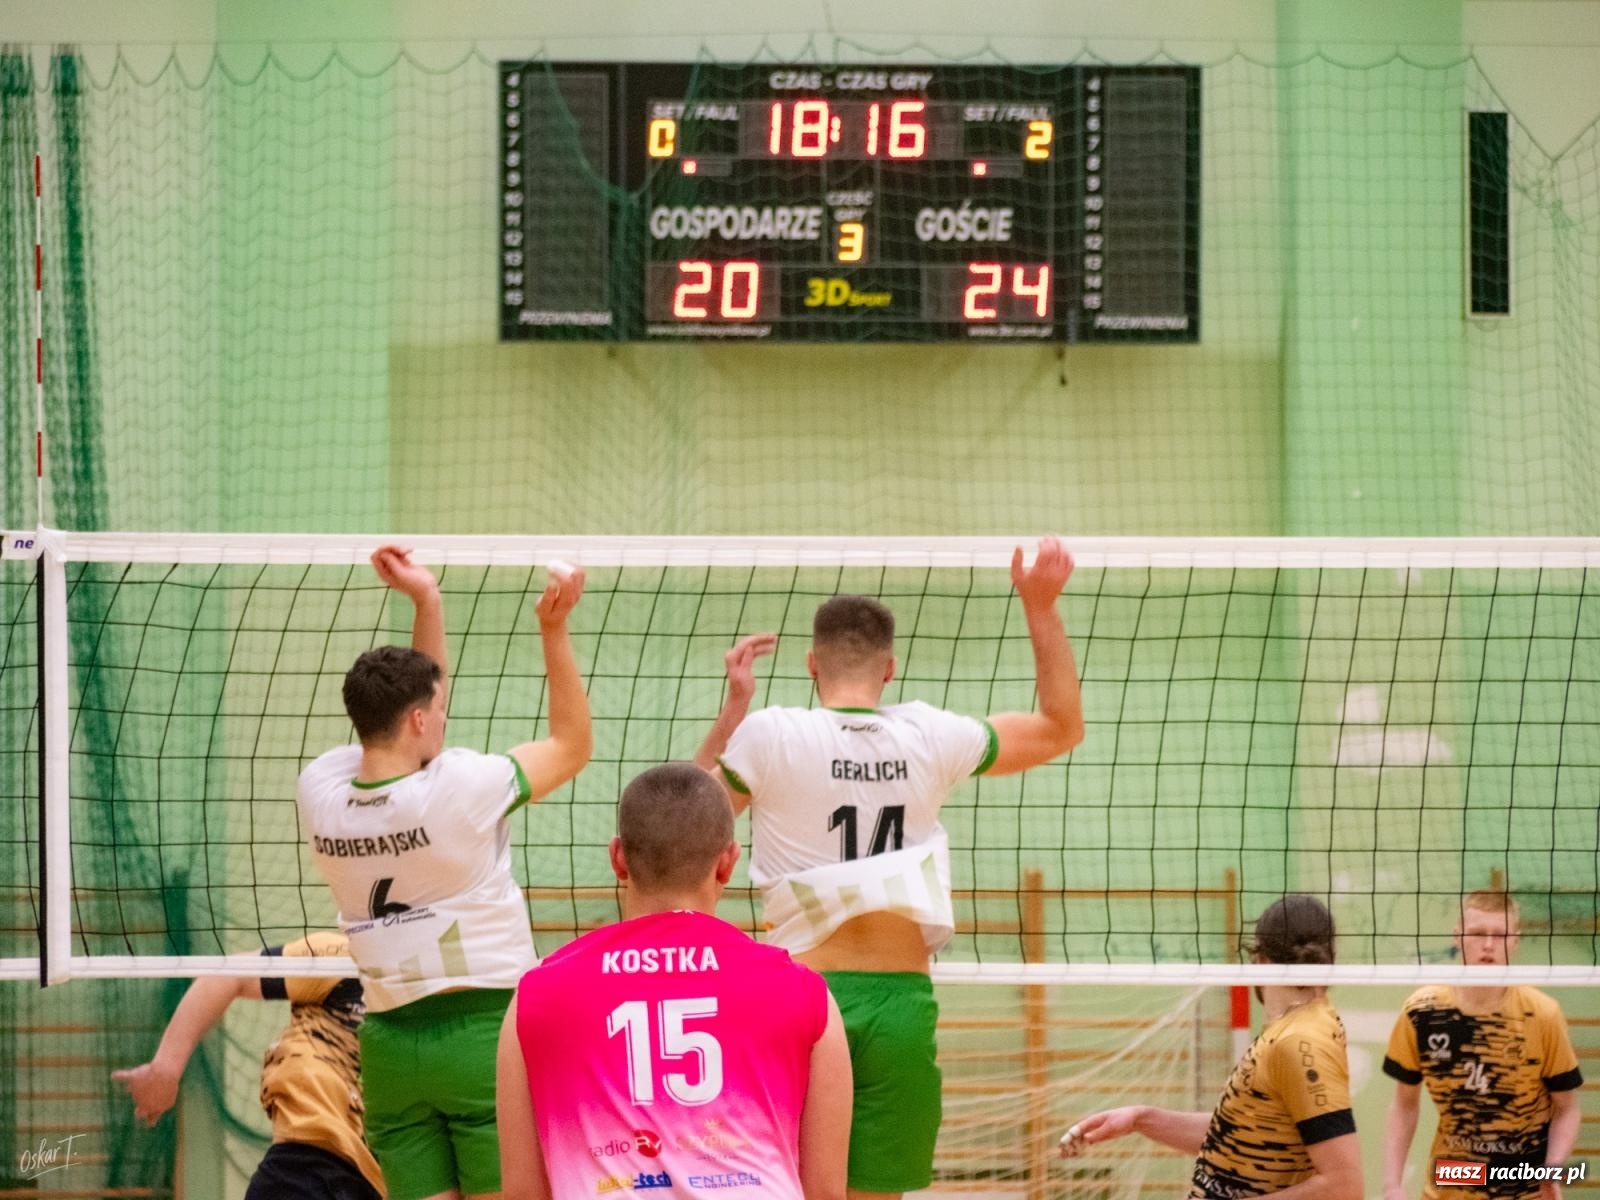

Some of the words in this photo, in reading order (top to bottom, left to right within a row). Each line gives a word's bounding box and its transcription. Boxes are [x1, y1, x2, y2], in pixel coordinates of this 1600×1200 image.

[769, 72, 822, 90] CZAS
[836, 72, 888, 90] CZAS
[891, 72, 933, 91] GRY
[1024, 121, 1053, 160] 2
[650, 205, 824, 240] GOSPODARZE
[915, 200, 1014, 242] GOŚCIE
[837, 222, 865, 262] 3
[674, 261, 761, 319] 20
[963, 263, 1050, 320] 24
[831, 758, 909, 783] GERLICH
[313, 826, 431, 857] SOBIERAJSKI
[827, 805, 906, 864] 14
[601, 946, 720, 974] KOSTKA
[606, 996, 724, 1108] 15
[1463, 1061, 1490, 1095] 24
